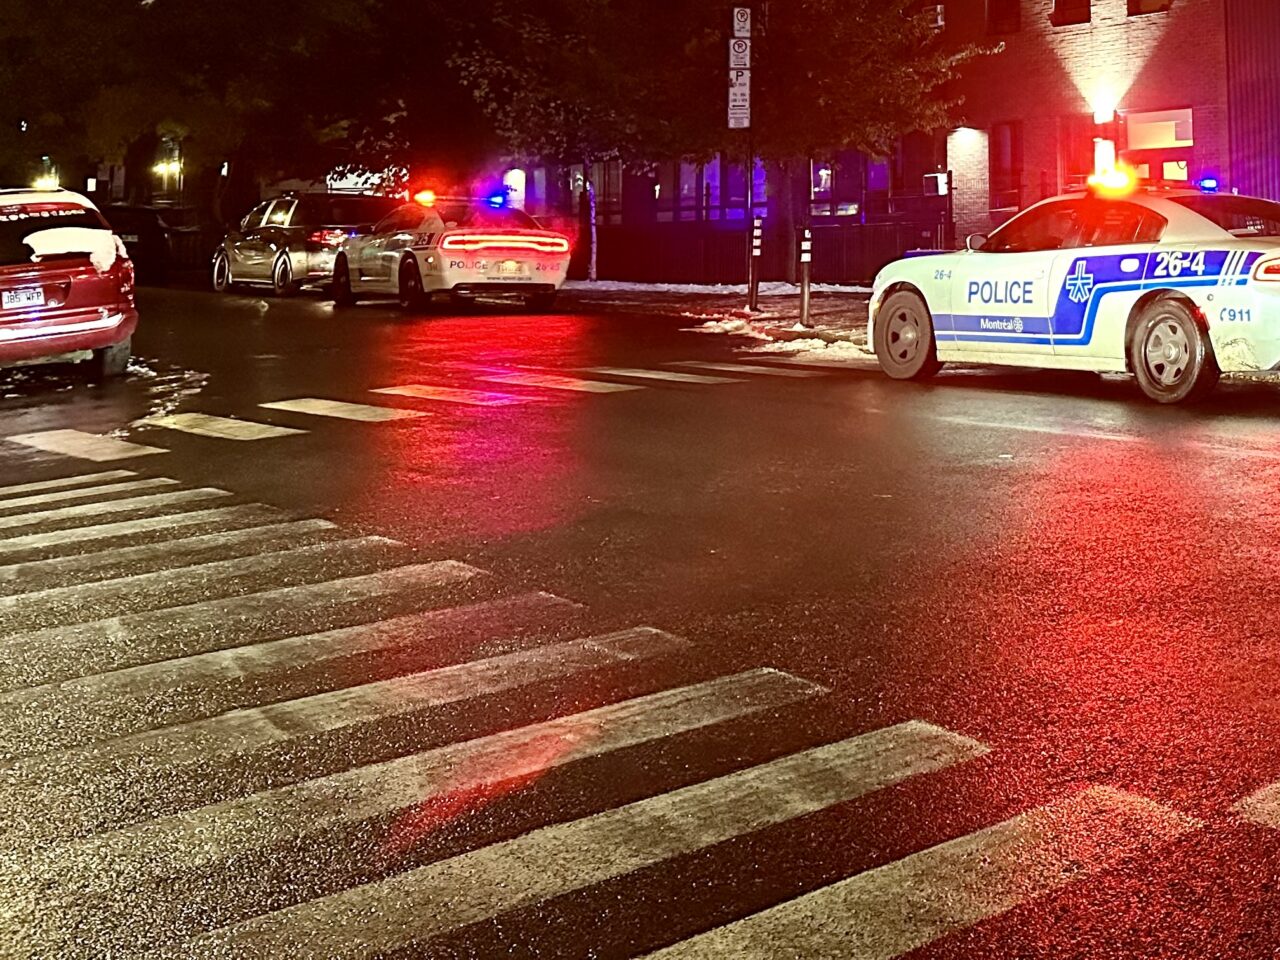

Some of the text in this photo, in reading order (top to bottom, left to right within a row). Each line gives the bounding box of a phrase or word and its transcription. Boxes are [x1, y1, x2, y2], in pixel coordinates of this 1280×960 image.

[450, 260, 489, 270] POLICE
[1153, 250, 1206, 277] 26-4
[934, 269, 952, 280] 26-4
[967, 280, 1034, 304] POLICE
[1228, 308, 1251, 322] 911
[980, 318, 1014, 331] Montréal
